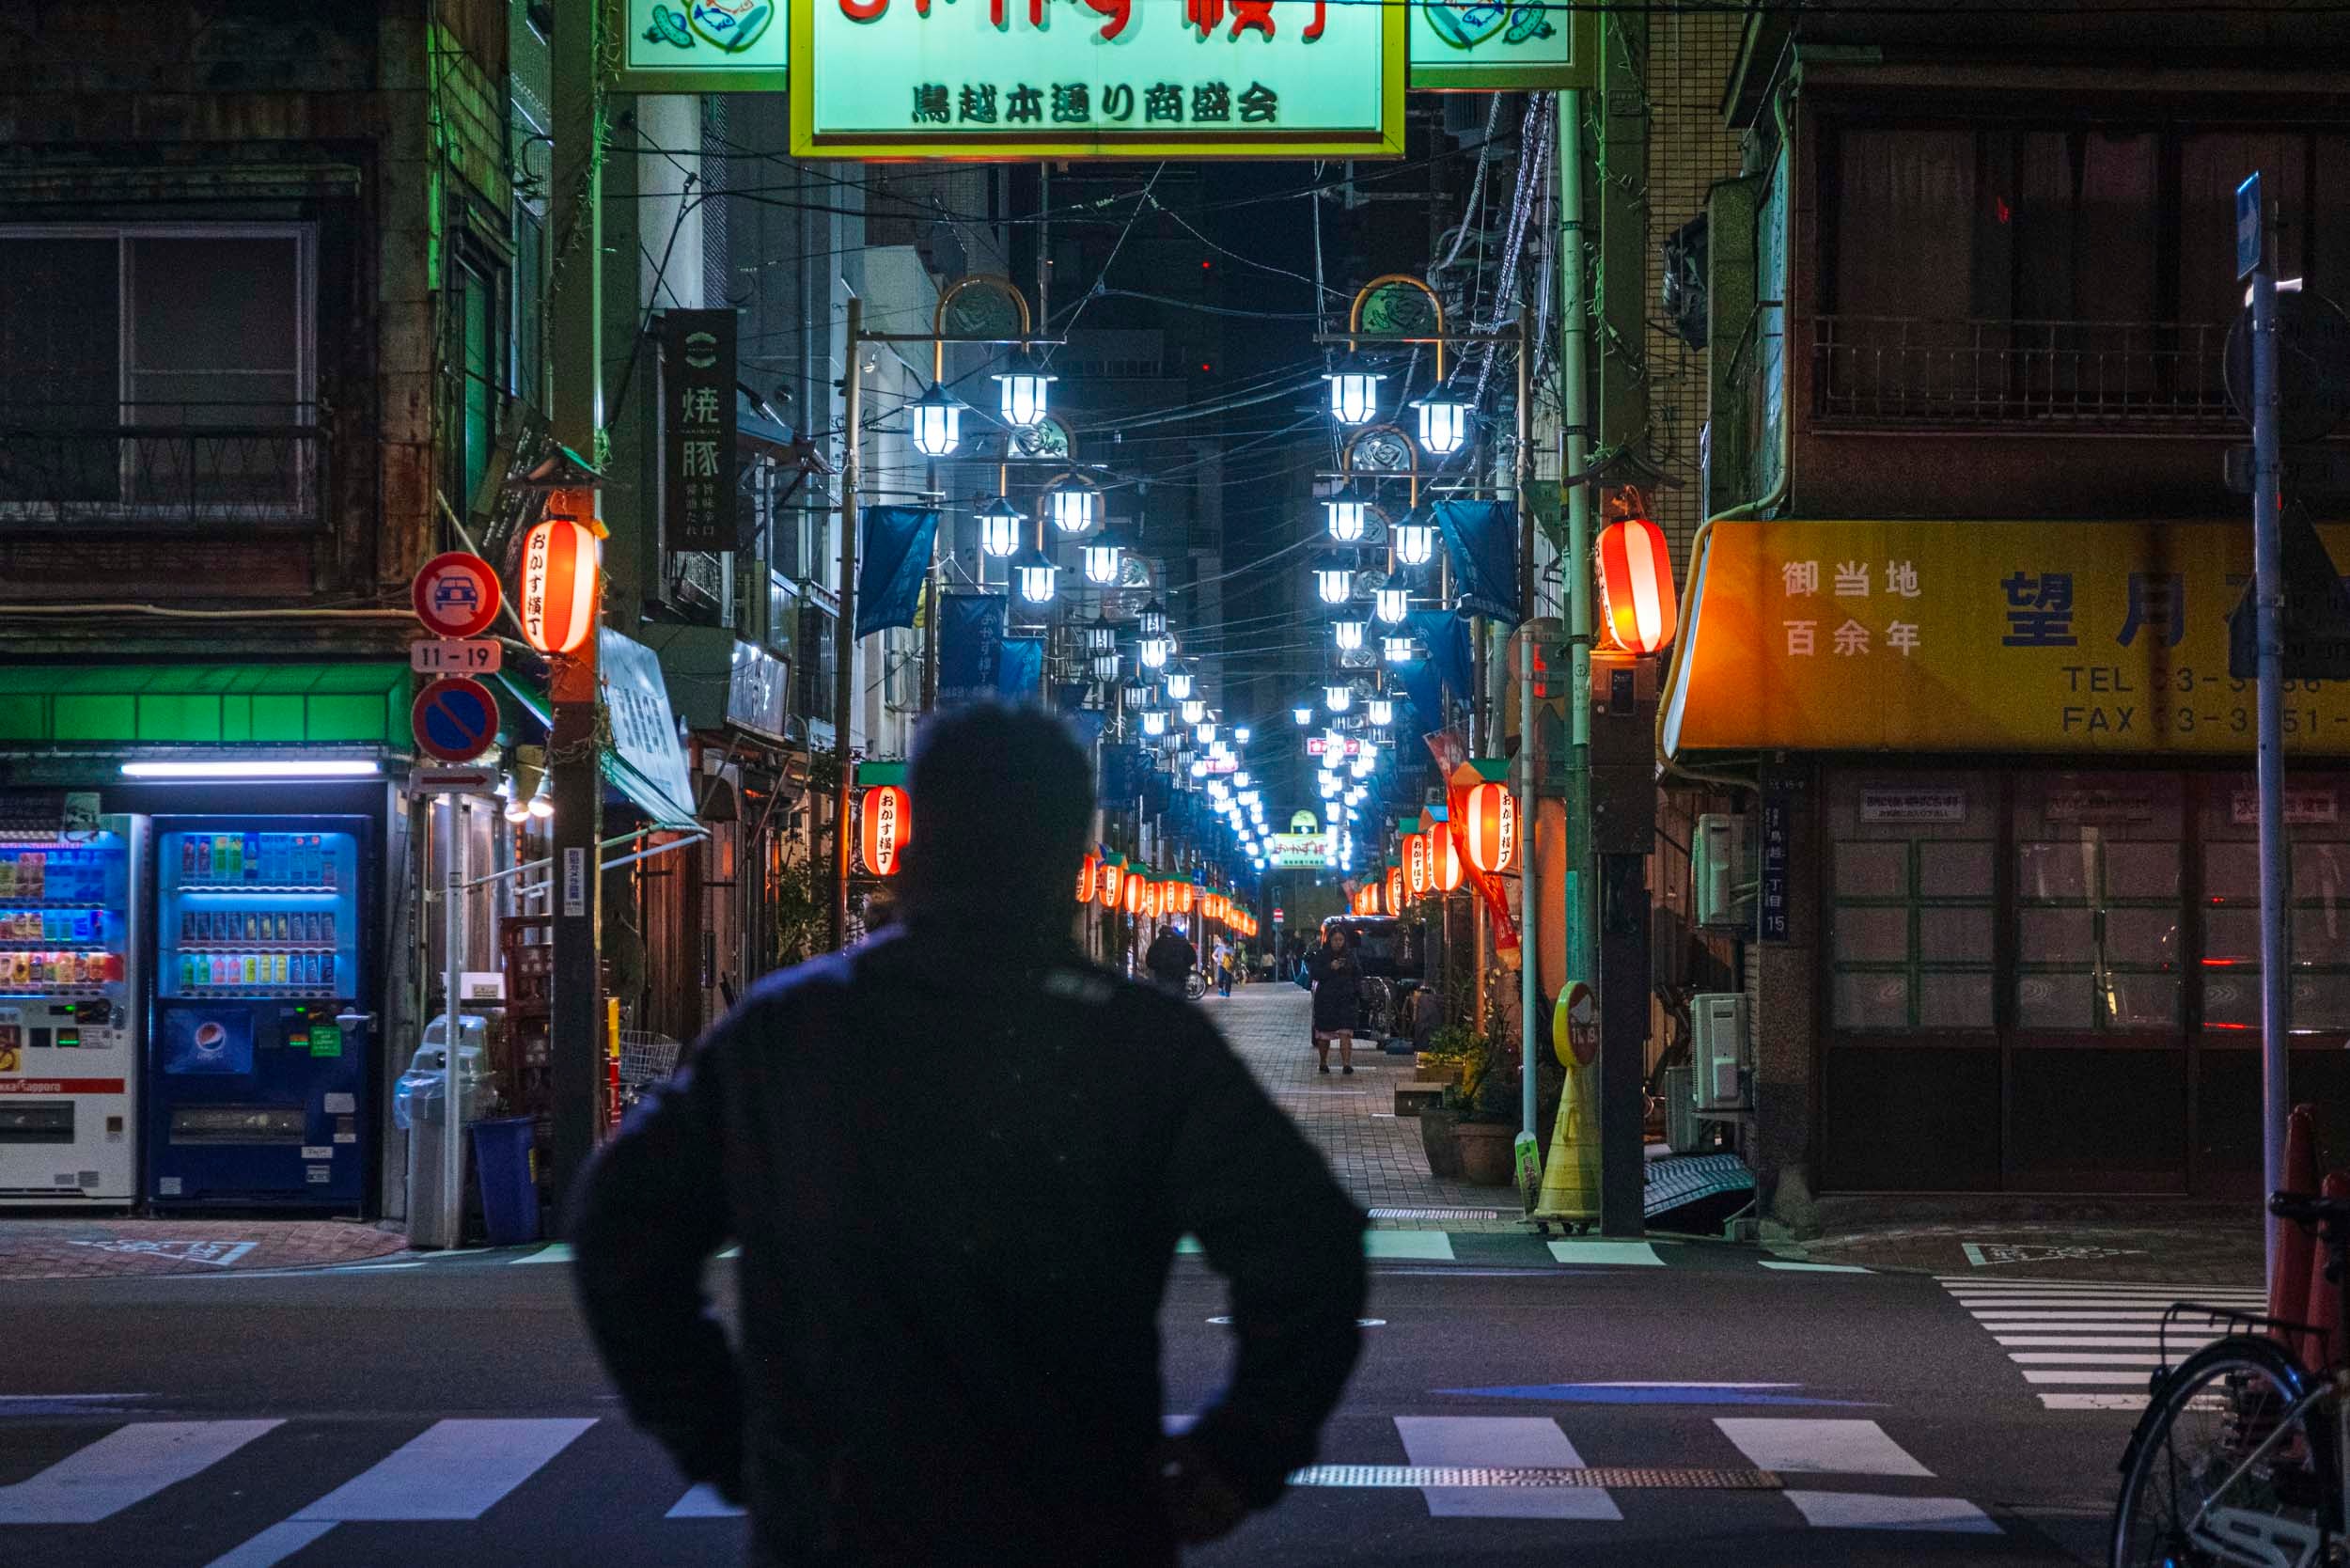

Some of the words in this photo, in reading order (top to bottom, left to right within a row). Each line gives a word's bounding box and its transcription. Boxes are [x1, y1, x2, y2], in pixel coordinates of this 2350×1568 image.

[911, 81, 1279, 123] 鳥越本通り商盛会
[682, 386, 719, 477] 焼豚
[1782, 561, 1921, 598] 御当地
[1999, 570, 2245, 647] 望月
[1782, 619, 1921, 656] 百余年
[2061, 666, 2134, 693] TEL
[2061, 706, 2135, 732] FAX
[878, 794, 894, 864] おかず横丁
[1767, 916, 1785, 932] 15
